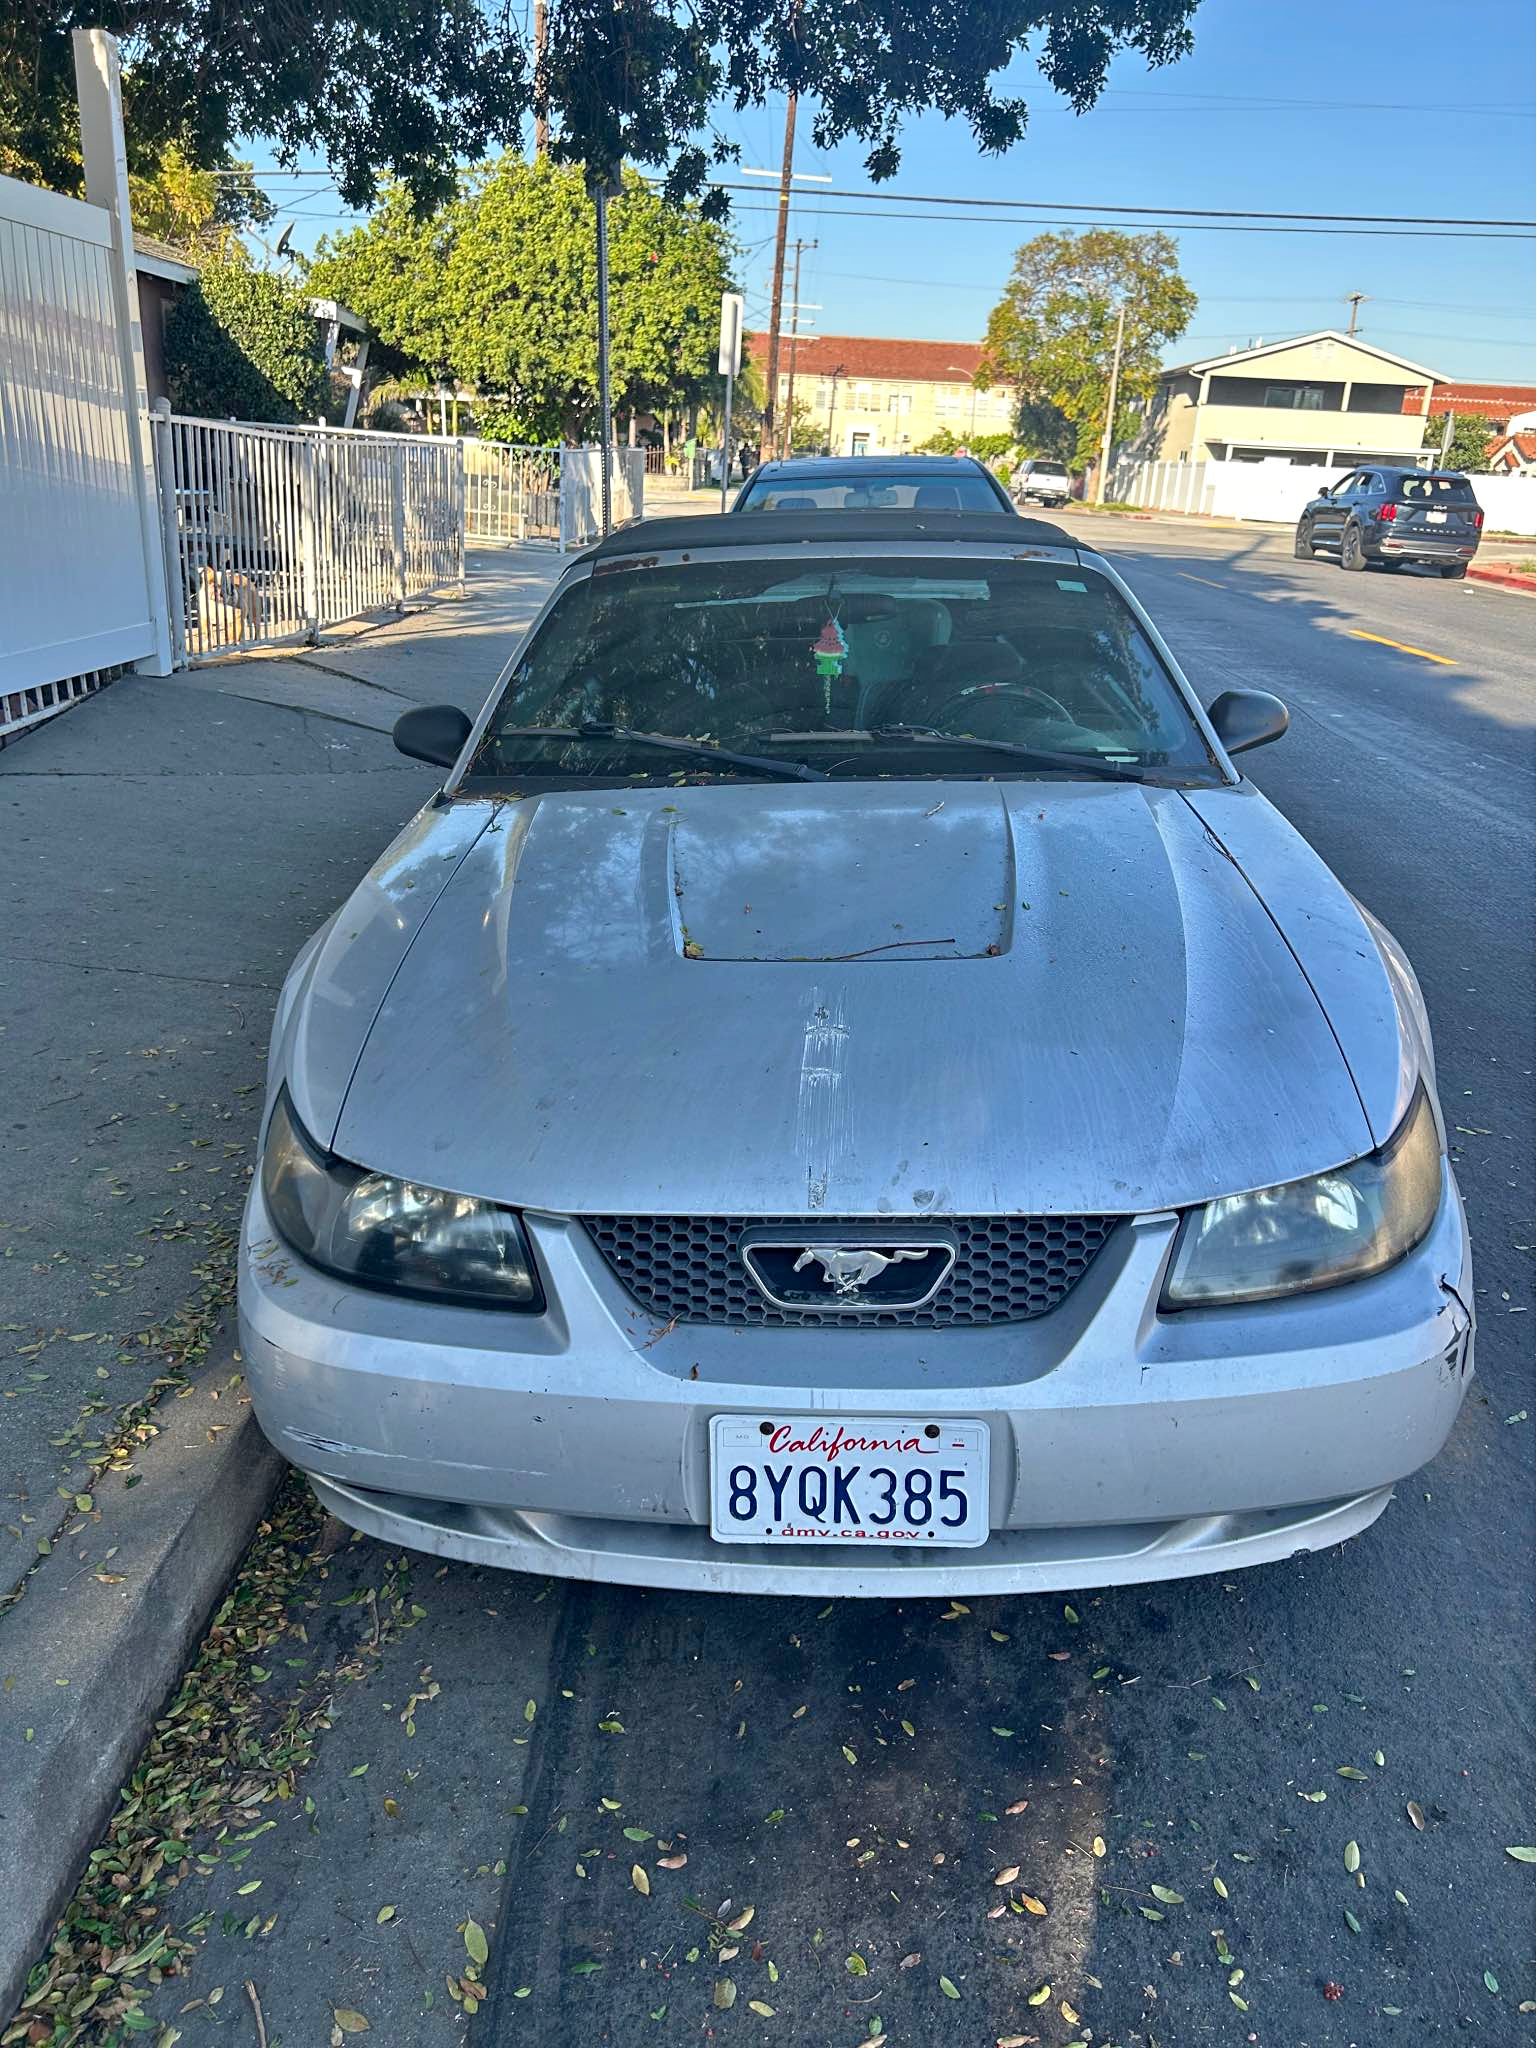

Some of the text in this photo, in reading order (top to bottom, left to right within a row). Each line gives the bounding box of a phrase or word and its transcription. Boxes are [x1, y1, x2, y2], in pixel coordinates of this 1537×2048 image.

[769, 1425, 940, 1461] California
[728, 1464, 968, 1527] 8YQK385
[781, 1527, 920, 1539] dmv.ca.gov
